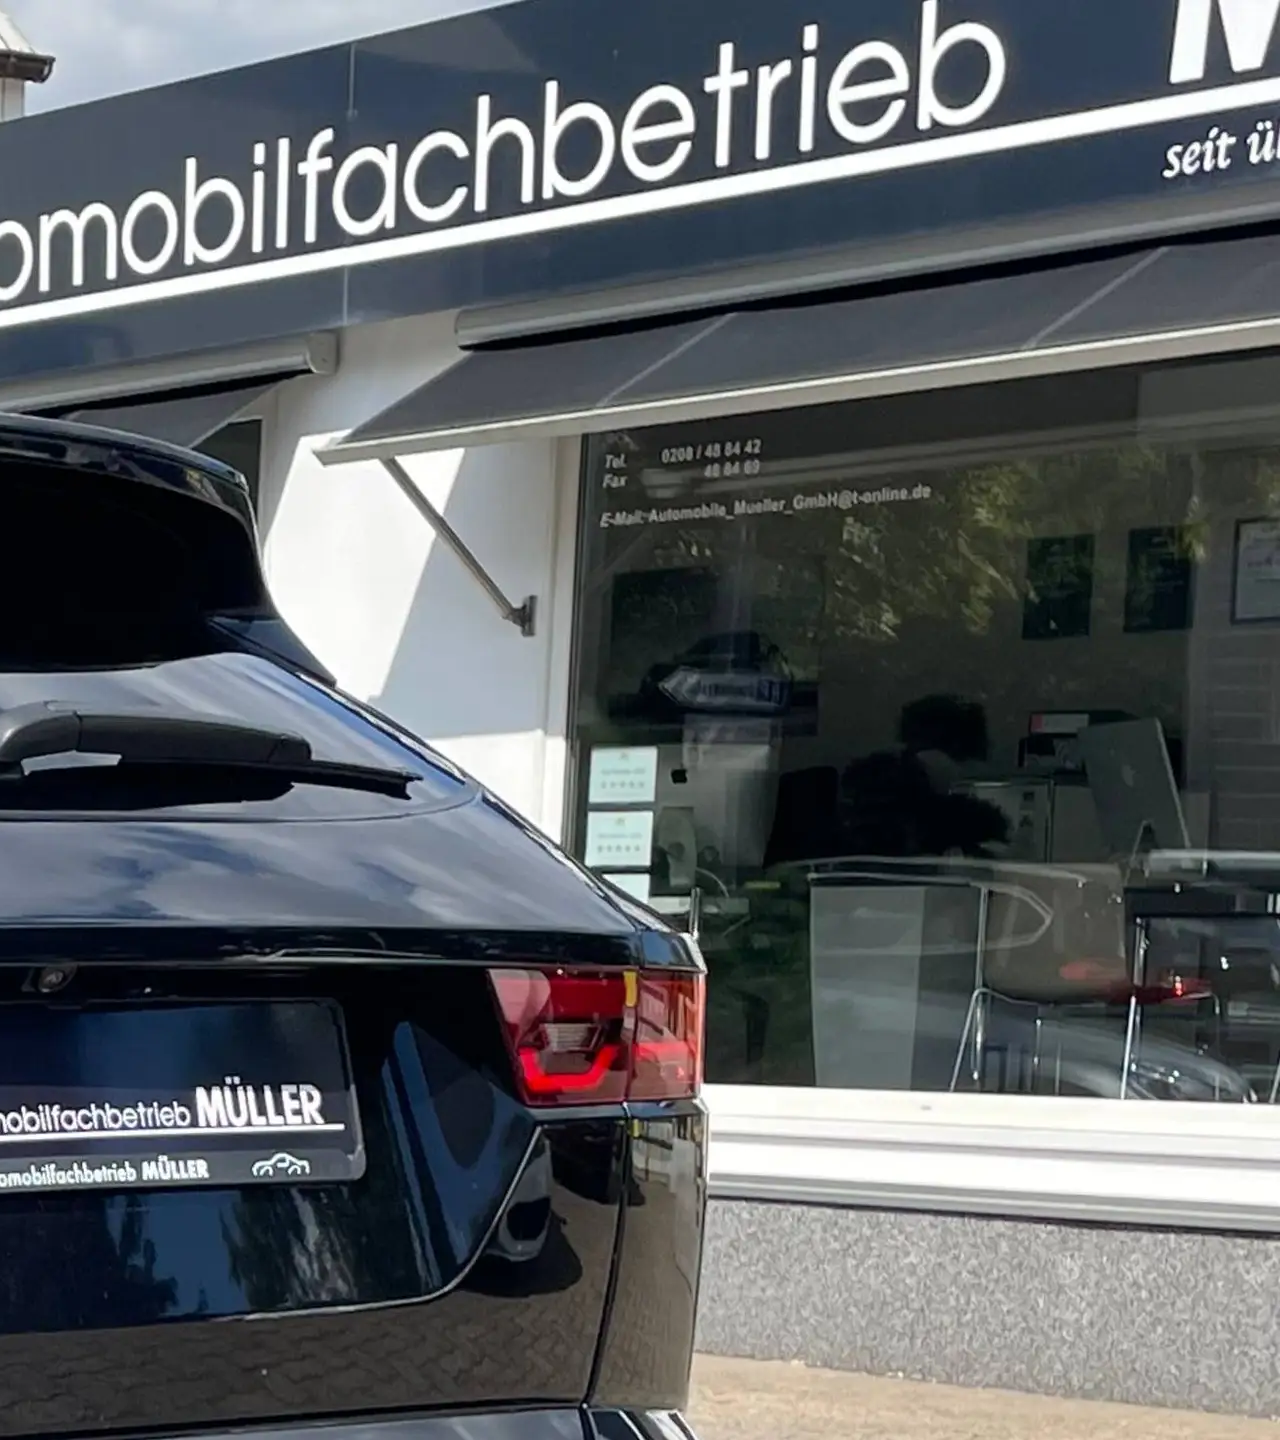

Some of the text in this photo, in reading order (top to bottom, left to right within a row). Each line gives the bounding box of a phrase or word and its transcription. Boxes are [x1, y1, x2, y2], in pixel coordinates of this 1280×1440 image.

[1162, 120, 1280, 178] seit ü
[661, 446, 694, 464] 0208
[704, 442, 721, 459] 48
[744, 438, 762, 454] 42
[602, 473, 628, 489] Fax
[704, 463, 720, 478] 48
[195, 1076, 325, 1127] MÜLLER
[141, 1154, 210, 1181] MÜLLER
